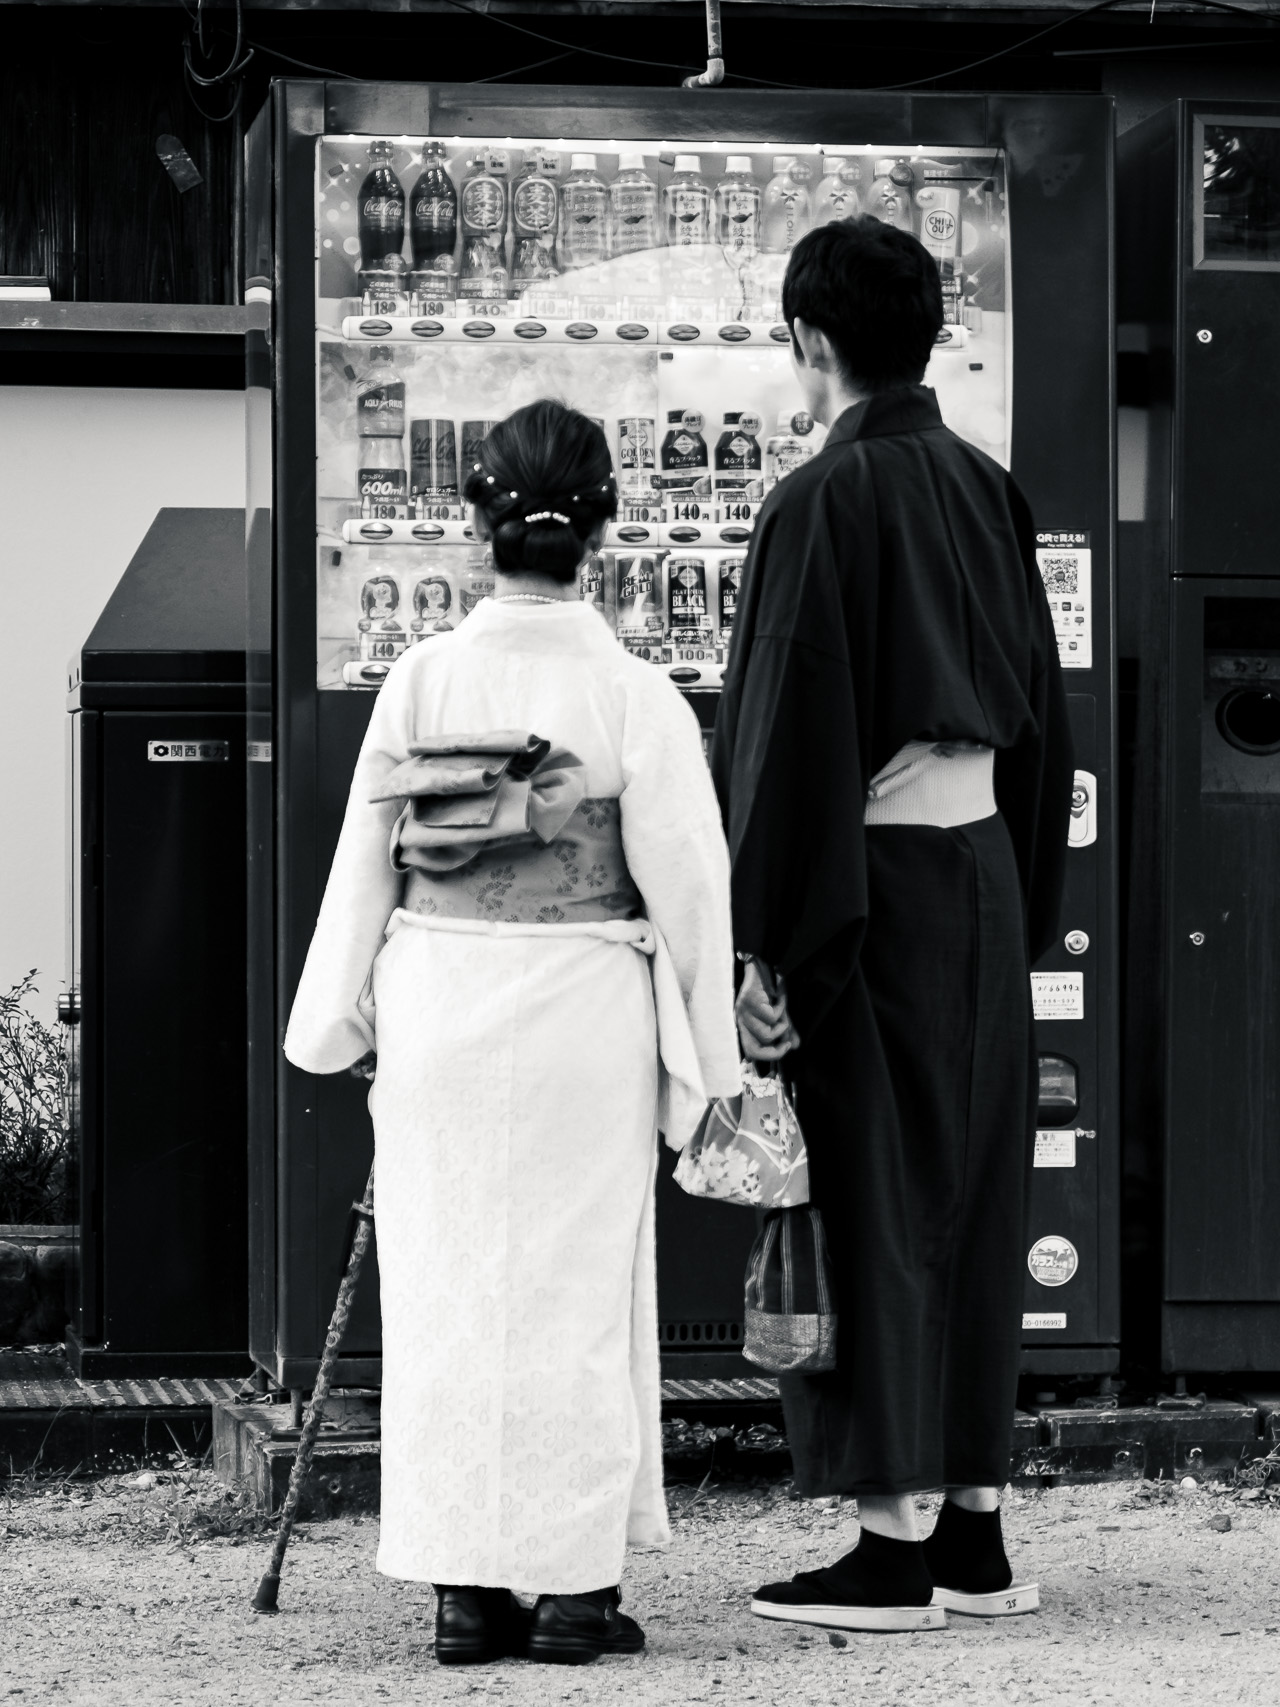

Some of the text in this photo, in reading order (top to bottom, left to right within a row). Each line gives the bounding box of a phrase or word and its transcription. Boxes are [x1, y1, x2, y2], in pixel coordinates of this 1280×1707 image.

[474, 182, 495, 224] 麦茶
[526, 184, 548, 226] 麦茶
[929, 217, 953, 227] CHILL
[932, 225, 950, 233] OUT
[364, 397, 403, 409] AQUARIUS
[621, 447, 654, 459] GOLDEN
[362, 482, 403, 495] 600ml
[623, 581, 652, 598] GOLD
[672, 595, 704, 606] BLACK
